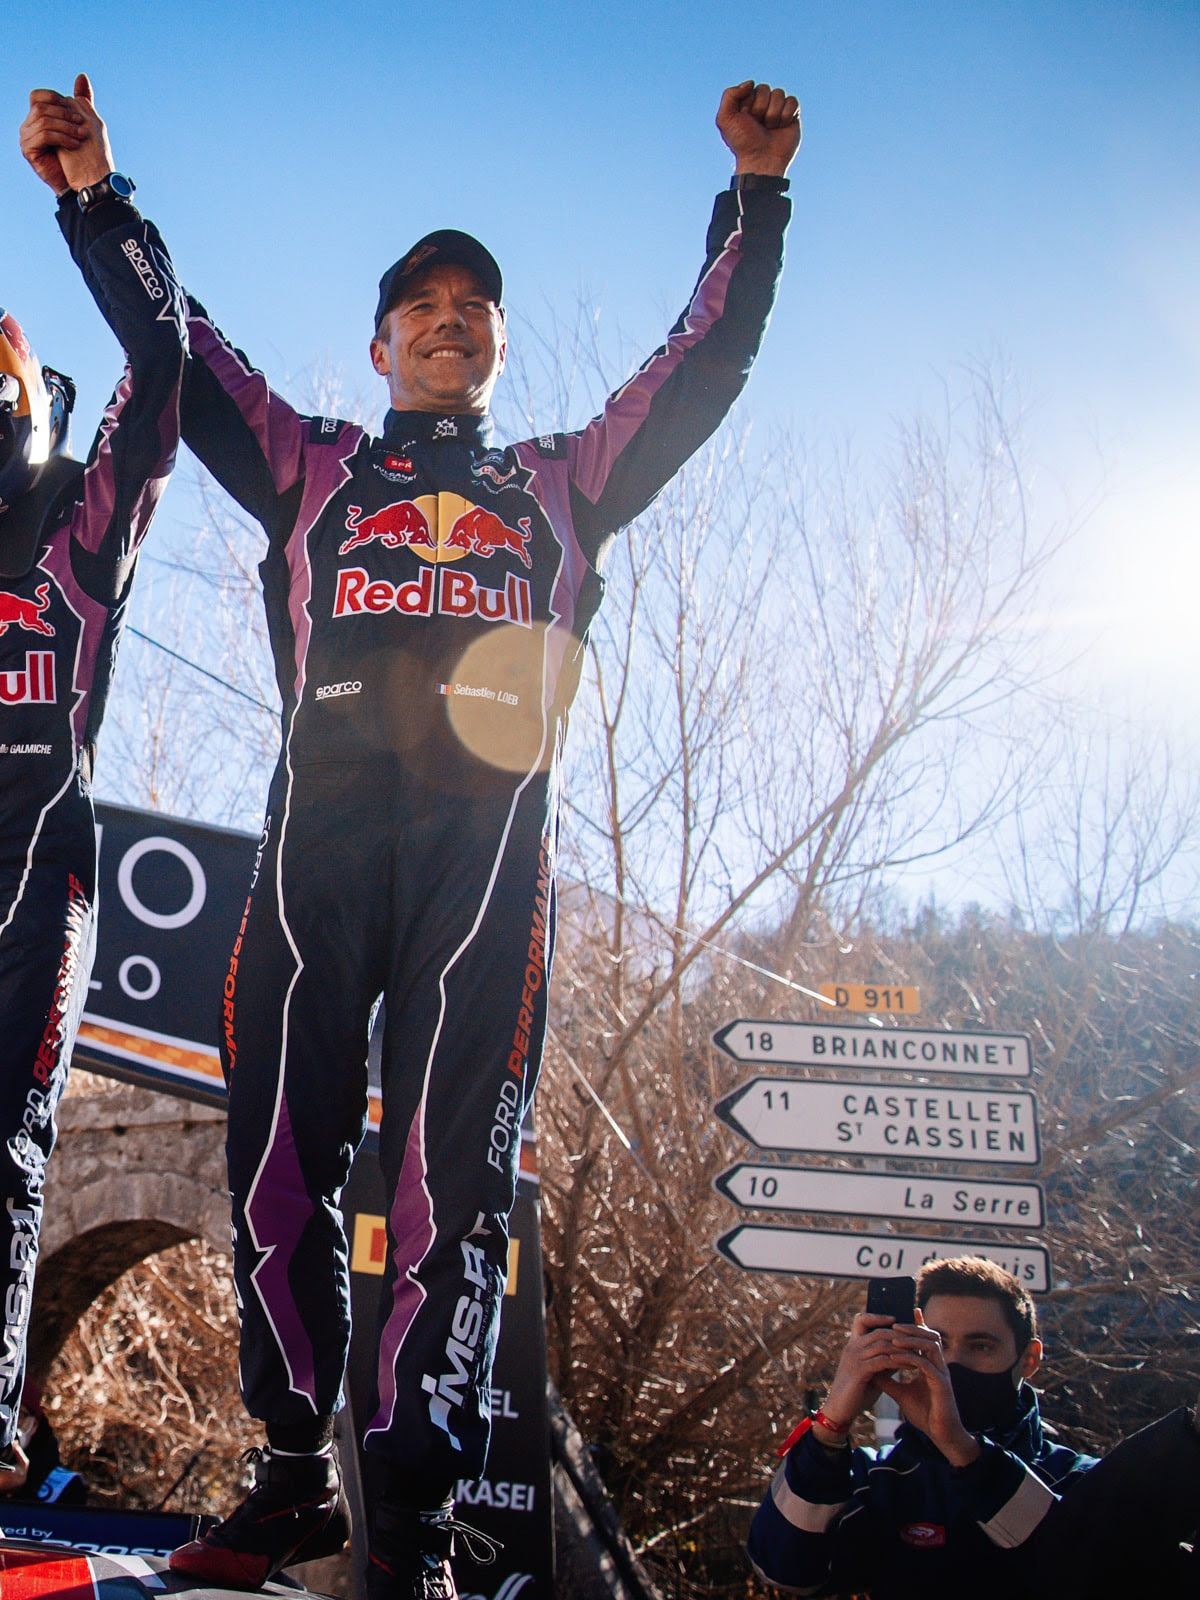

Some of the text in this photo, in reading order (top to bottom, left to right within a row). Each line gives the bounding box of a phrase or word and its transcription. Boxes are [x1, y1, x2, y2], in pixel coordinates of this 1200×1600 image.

[121, 239, 164, 300] sparco
[332, 565, 533, 629] Red Bull
[315, 680, 363, 700] sparco
[453, 684, 496, 700] Sebastien
[9, 744, 53, 755] GALMICHE
[834, 987, 906, 1010] D 911
[745, 1031, 1017, 1066] 18 BRIANCONNET
[763, 1090, 1023, 1124] 11 CASTELLET
[487, 1079, 520, 1174] FORD
[884, 1125, 1026, 1153] CASSIEN
[749, 1176, 1031, 1217] 10 La Serre
[856, 1245, 904, 1270] Col
[456, 1479, 535, 1512] KASEI
